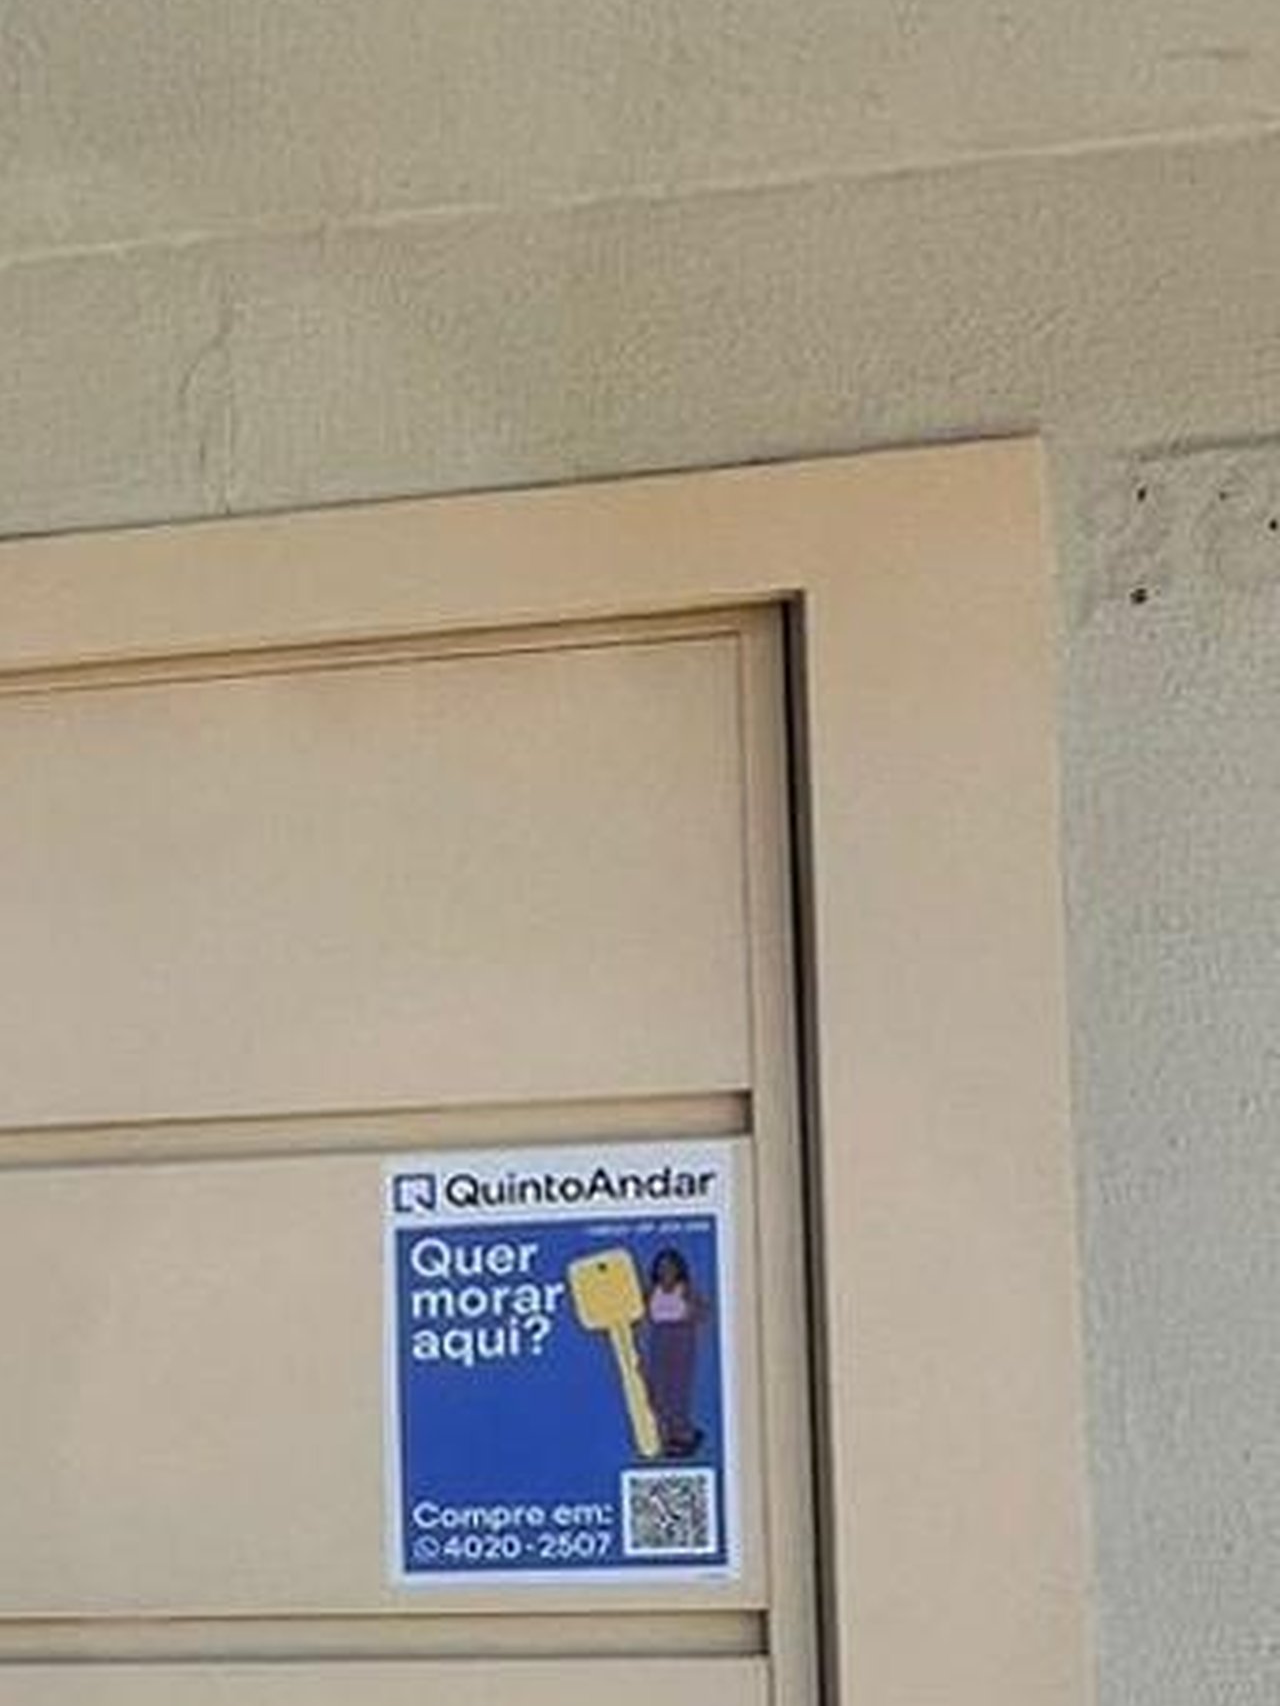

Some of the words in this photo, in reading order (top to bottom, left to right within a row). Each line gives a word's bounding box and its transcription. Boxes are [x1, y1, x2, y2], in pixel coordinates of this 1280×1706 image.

[445, 1167, 716, 1208] QuintoAndar
[410, 1237, 539, 1279] Quer
[410, 1280, 565, 1319] morar
[410, 1316, 552, 1366] aqui?
